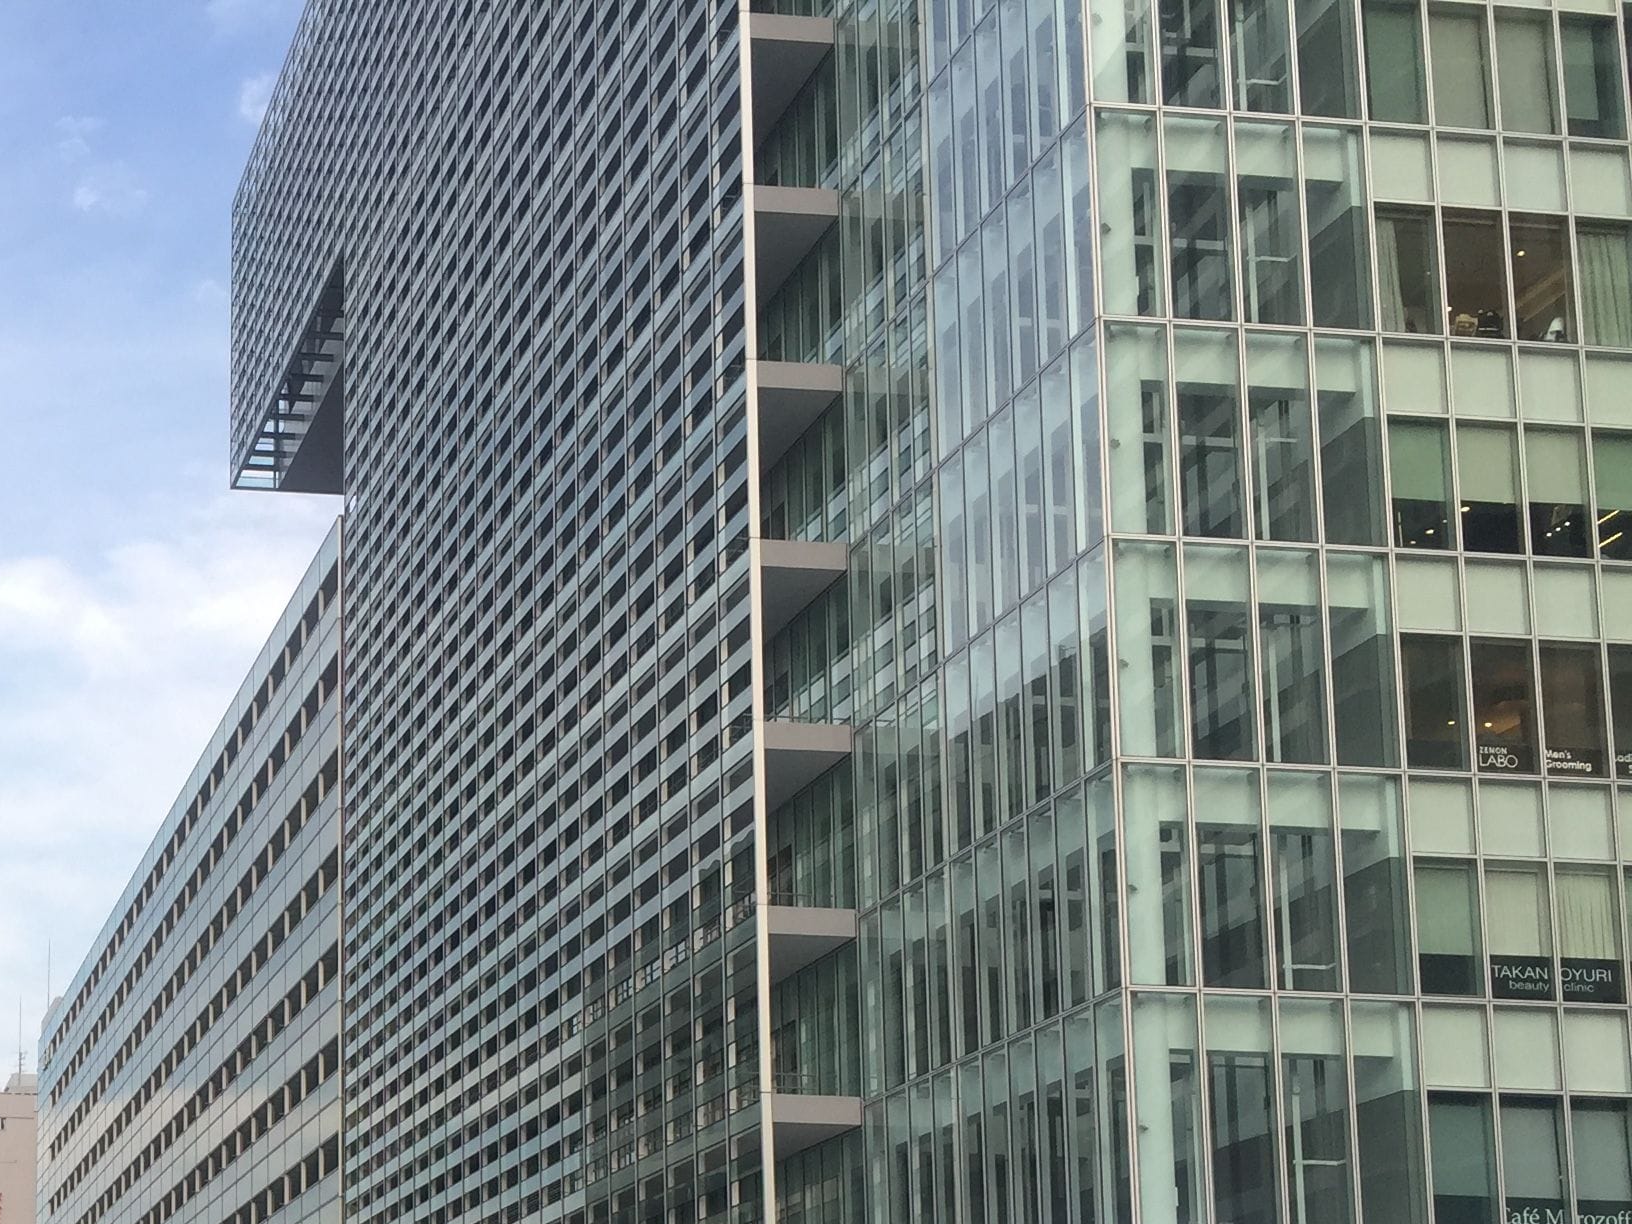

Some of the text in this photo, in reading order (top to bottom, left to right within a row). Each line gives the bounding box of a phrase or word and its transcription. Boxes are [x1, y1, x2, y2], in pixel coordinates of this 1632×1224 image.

[1479, 754, 1518, 768] LABO
[1545, 759, 1592, 772] Grooming
[1509, 980, 1595, 993] beauty clinic
